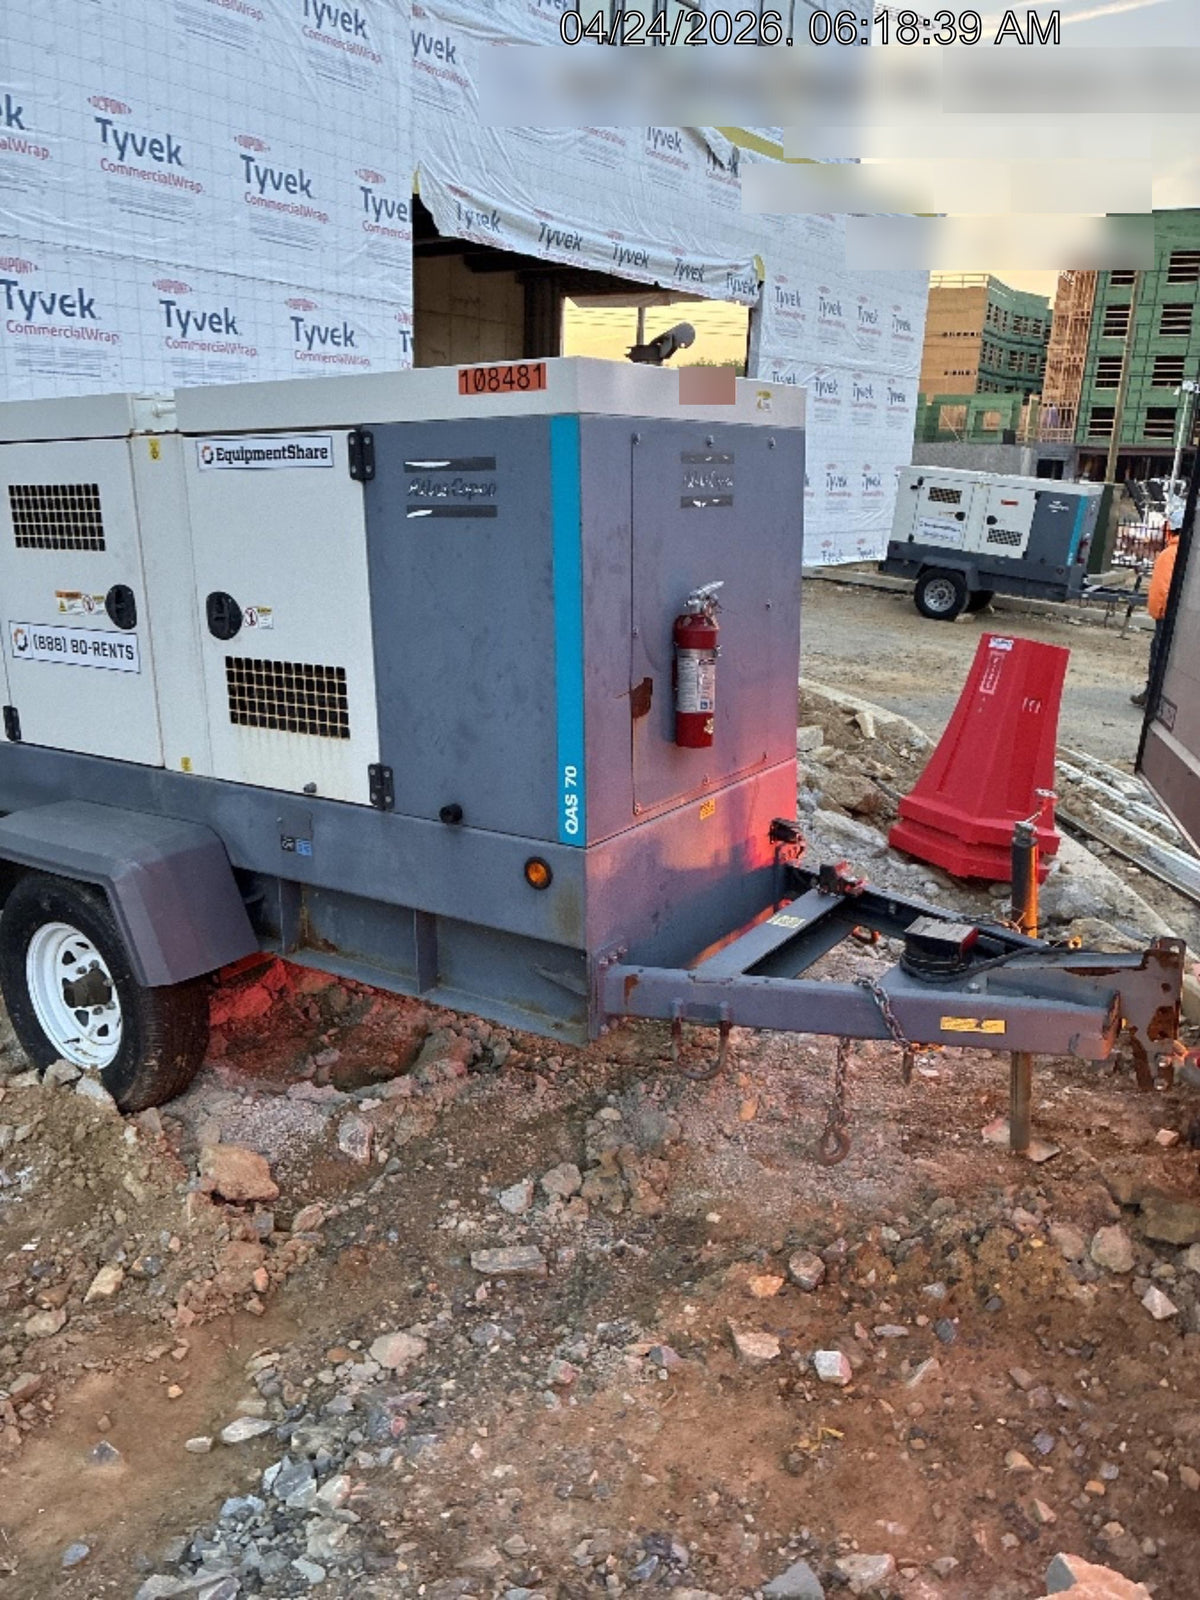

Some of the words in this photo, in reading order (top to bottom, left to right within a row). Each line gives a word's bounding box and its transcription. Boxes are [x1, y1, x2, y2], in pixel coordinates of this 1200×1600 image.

[411, 30, 456, 65] yvek
[94, 116, 184, 167] Tyvek
[240, 154, 314, 200] Tyvek
[538, 222, 583, 251] Tyvek
[612, 242, 650, 269] Tyvek
[674, 257, 705, 282] Tyvek
[727, 272, 757, 296] Tyvek
[0, 278, 97, 321] Tyvek
[6, 319, 120, 346] CommercialWrap
[159, 299, 239, 338] Tyvek
[290, 316, 356, 351] Tyvek
[460, 364, 546, 393] 108481
[216, 444, 328, 464] EquipmentShare
[33, 633, 67, 653] (888)
[71, 638, 135, 660] 80-RENTS
[564, 765, 577, 788] 70
[565, 794, 579, 834] QAS
